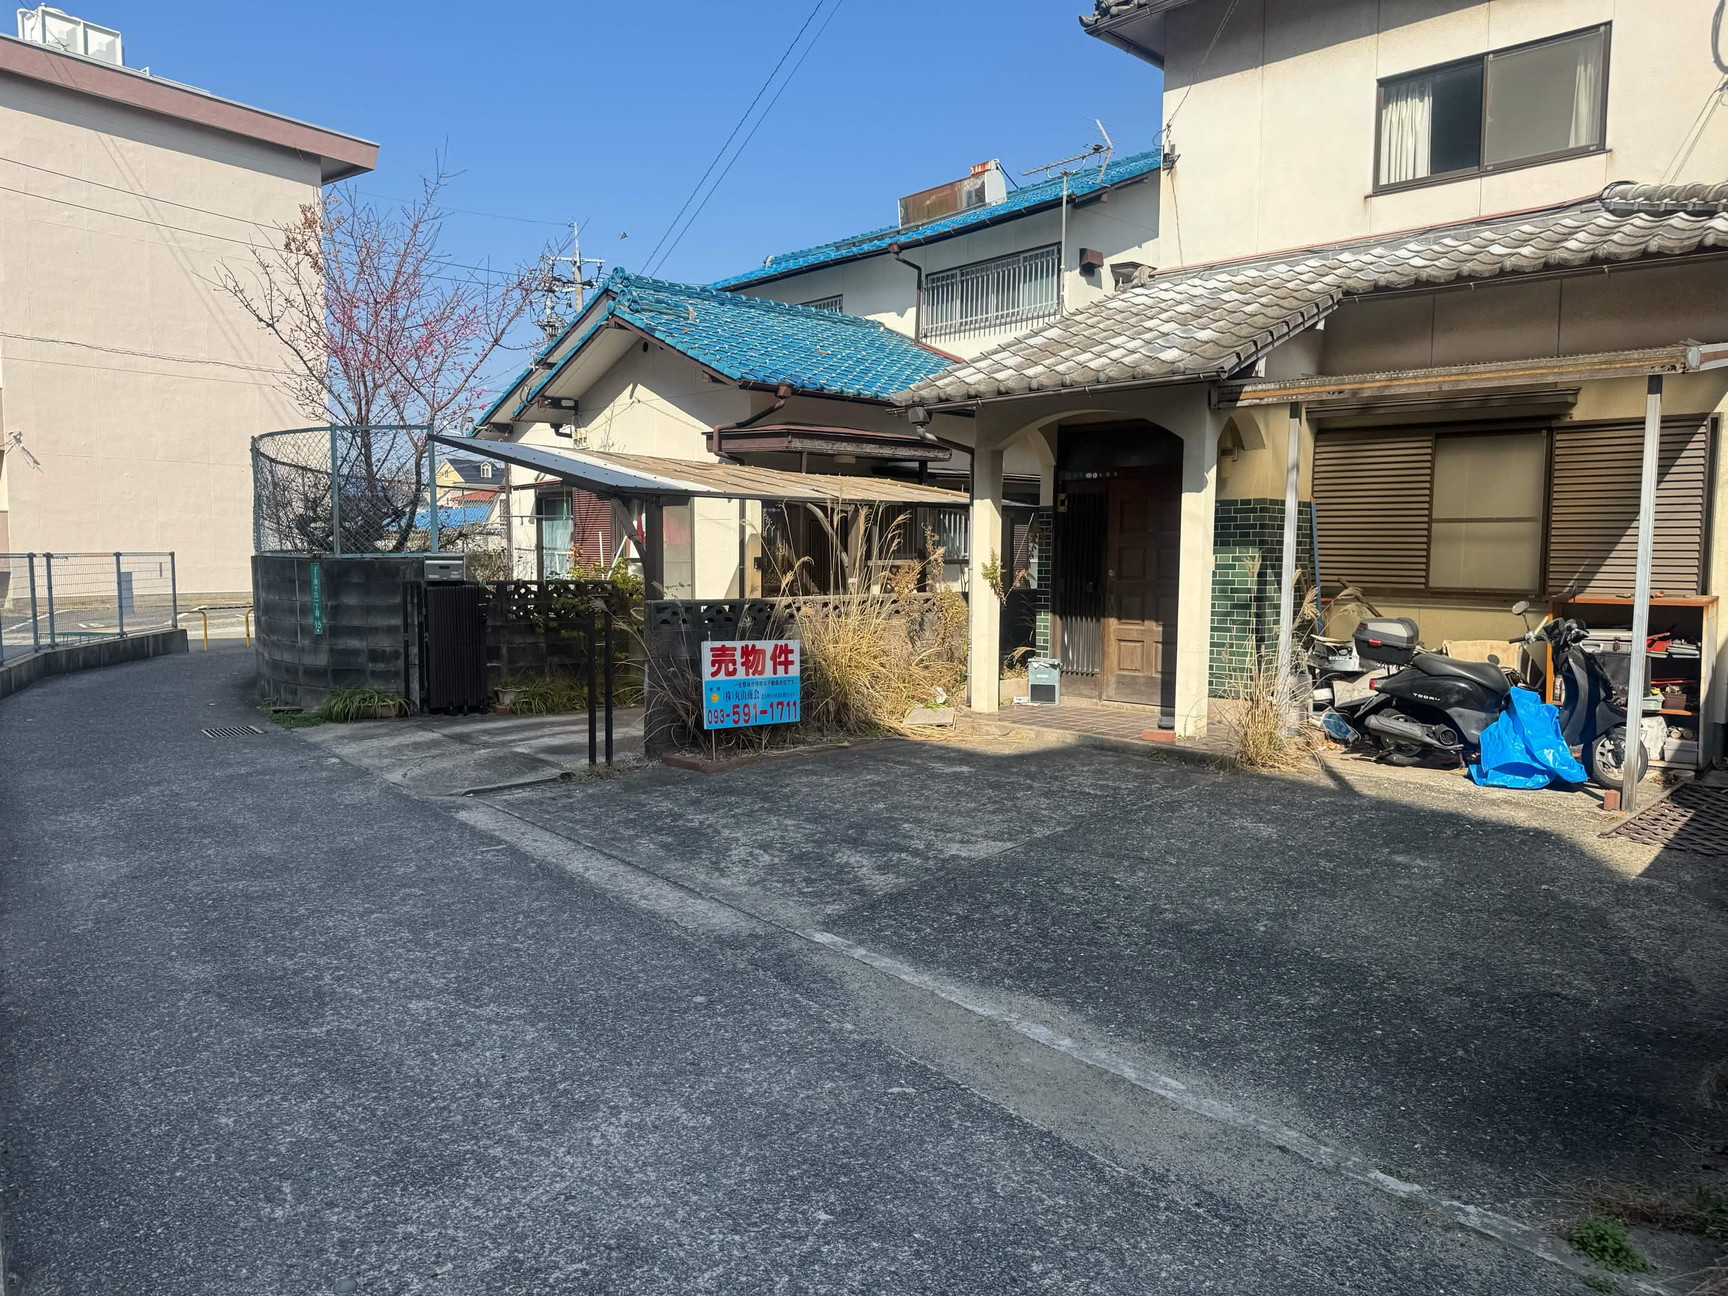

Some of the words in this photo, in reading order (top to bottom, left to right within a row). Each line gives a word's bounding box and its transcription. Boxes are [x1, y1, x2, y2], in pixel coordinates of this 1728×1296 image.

[709, 643, 795, 678] 売物件
[707, 699, 797, 725] 093-591-1711
